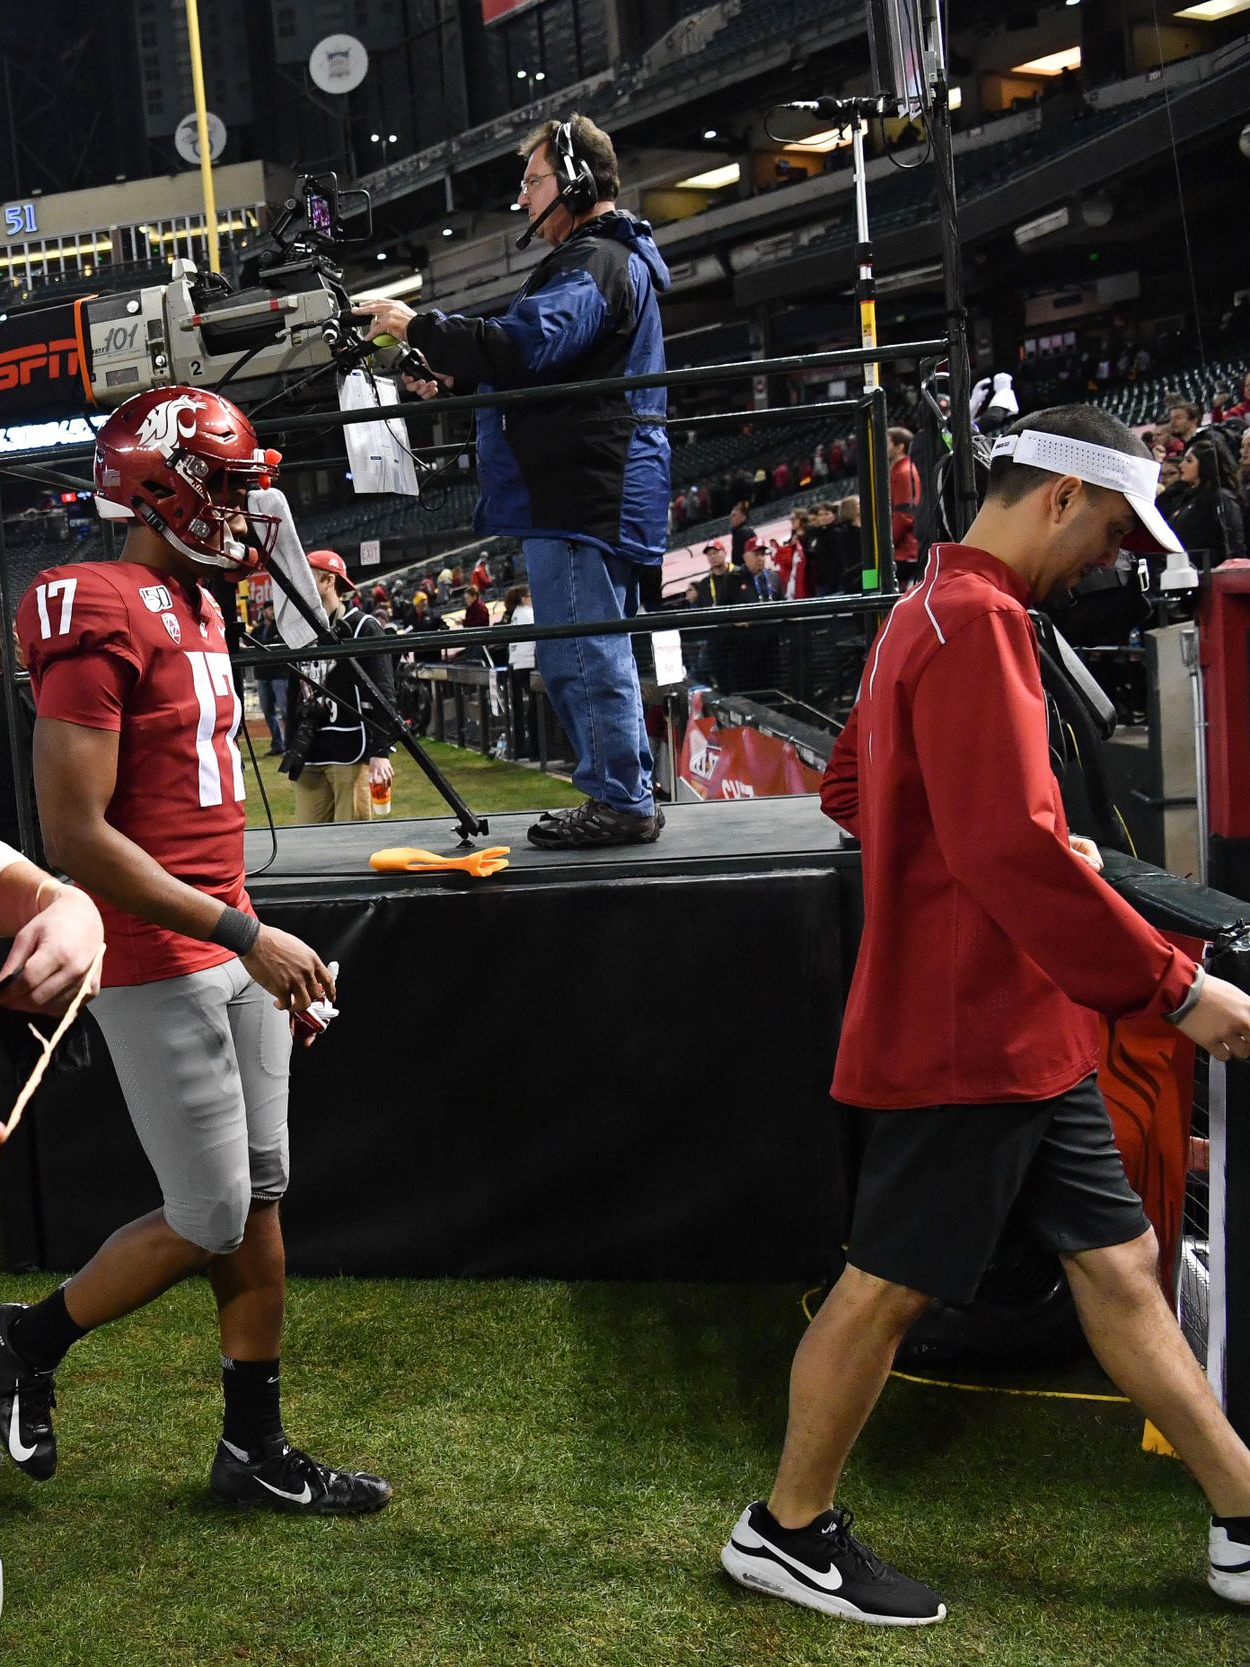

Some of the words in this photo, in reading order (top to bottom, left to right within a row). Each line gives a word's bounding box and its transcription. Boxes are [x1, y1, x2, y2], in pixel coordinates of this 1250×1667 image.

[4, 203, 39, 236] 51
[190, 361, 203, 376] 2
[35, 577, 78, 640] 17
[183, 651, 247, 808] 17
